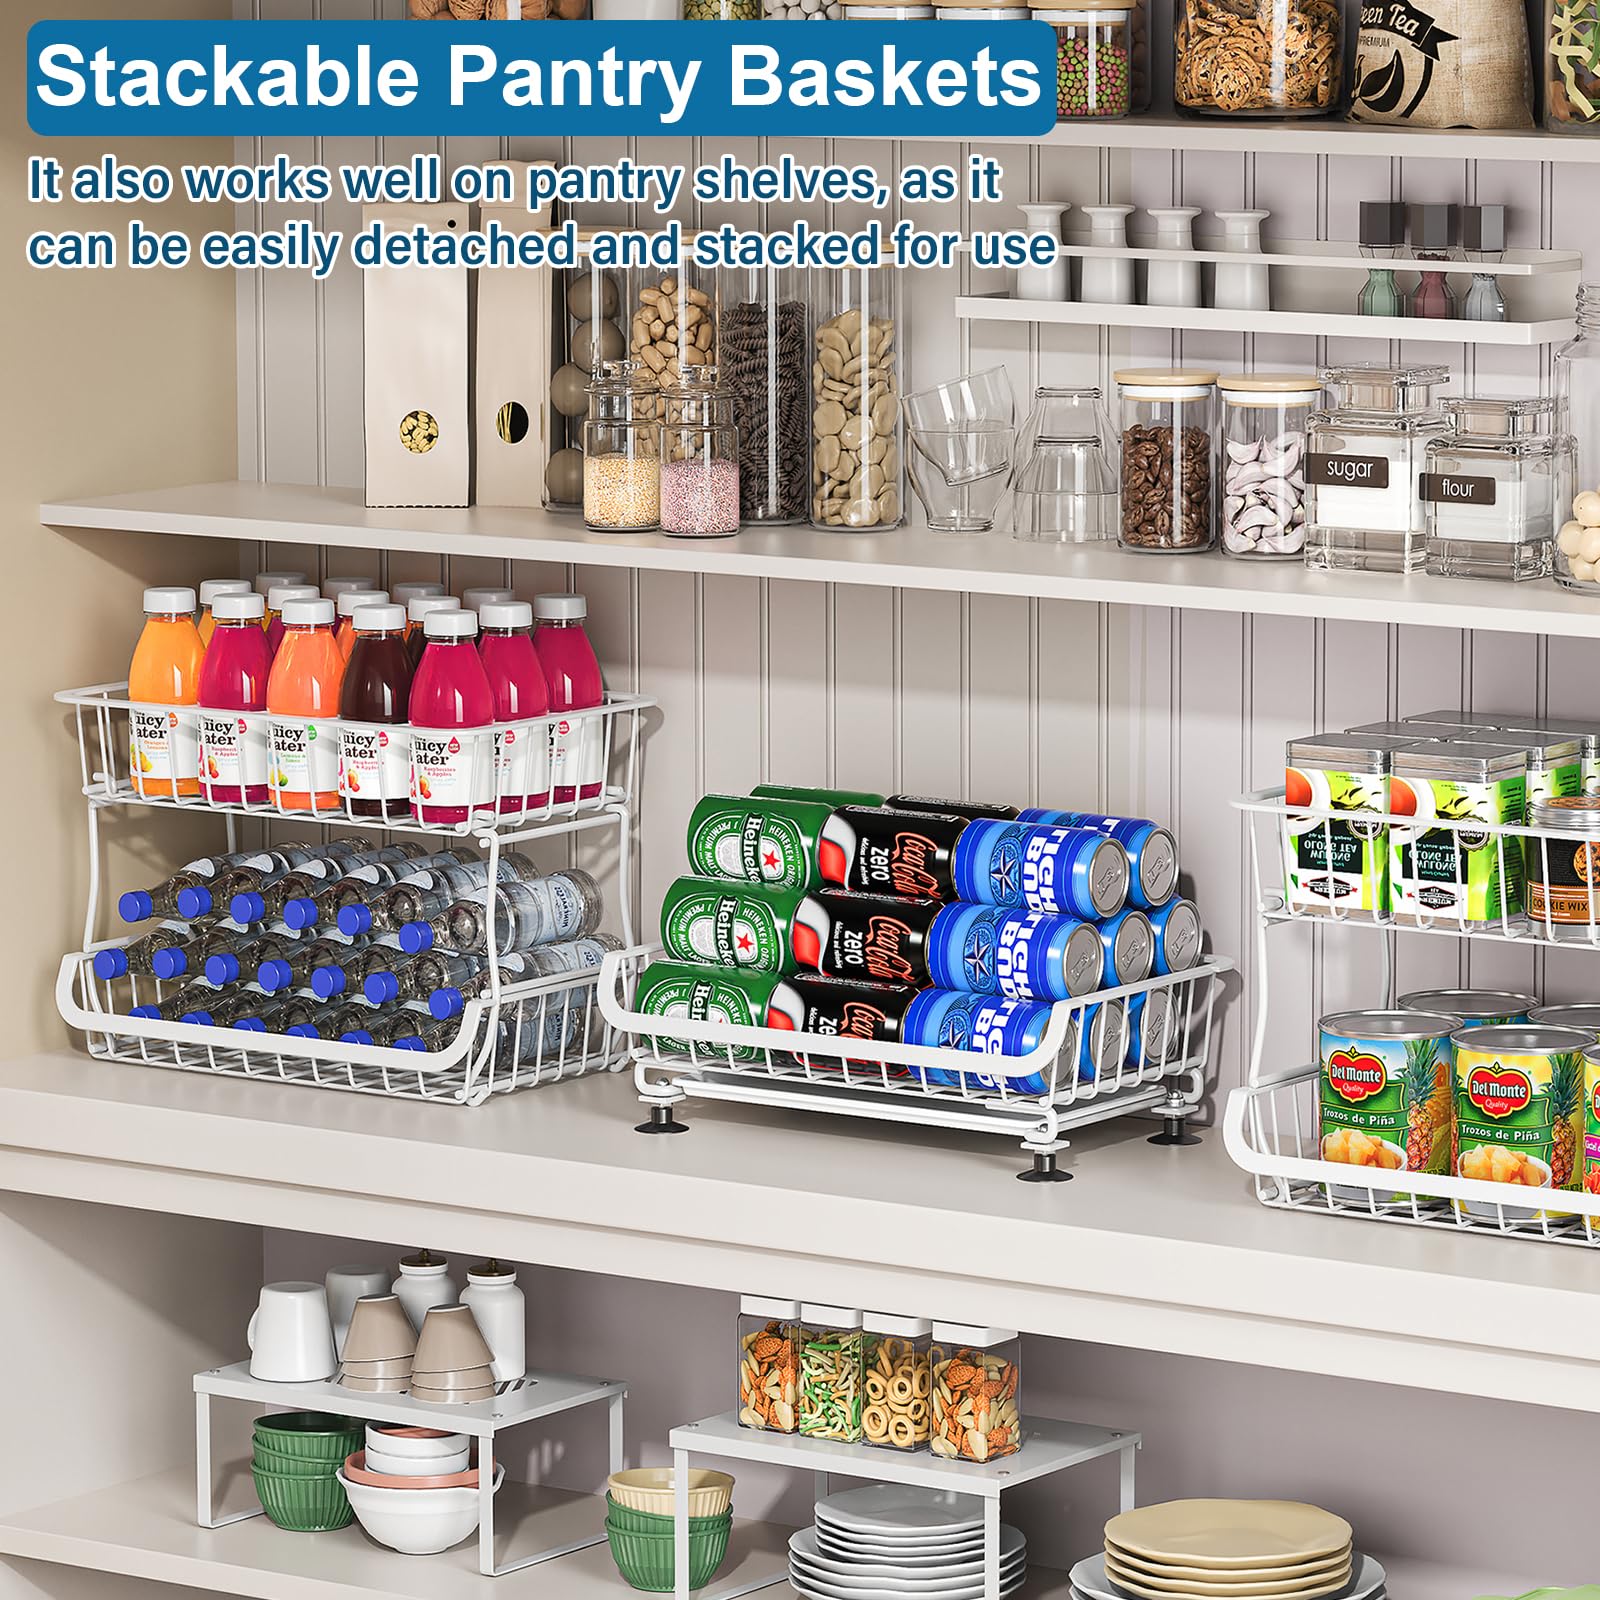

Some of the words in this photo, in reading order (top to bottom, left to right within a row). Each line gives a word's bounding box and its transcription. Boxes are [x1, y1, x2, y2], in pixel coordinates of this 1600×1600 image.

[1389, 3, 1420, 37] Tea
[1327, 460, 1374, 481] sugar
[1442, 478, 1475, 498] flour
[704, 820, 732, 850] PREMIUM
[768, 824, 795, 863] HEINEKEN
[704, 850, 718, 870] MALT
[743, 817, 764, 883] Heineke
[870, 846, 890, 881] zero
[1533, 898, 1565, 911] COKIE
[678, 903, 706, 933] PREMIUM
[742, 907, 768, 945] HEINEKEN
[678, 933, 692, 954] MALT
[717, 899, 737, 967] Heineke
[843, 930, 865, 965] zero
[717, 992, 743, 1024] HEINEKE
[818, 1015, 838, 1036] ze
[1331, 1063, 1345, 1077] Del
[1346, 1066, 1382, 1083] Monte
[1342, 1082, 1365, 1095] Quality
[1471, 1080, 1488, 1096] Del
[1490, 1082, 1527, 1098] Monte
[1485, 1098, 1509, 1110] Quality
[1323, 1107, 1349, 1121] Trozos
[1351, 1113, 1365, 1124] de
[1369, 1113, 1395, 1125] Piña
[1462, 1124, 1491, 1137] Trozos
[1495, 1129, 1510, 1140] de
[1514, 1130, 1540, 1142] Piña
